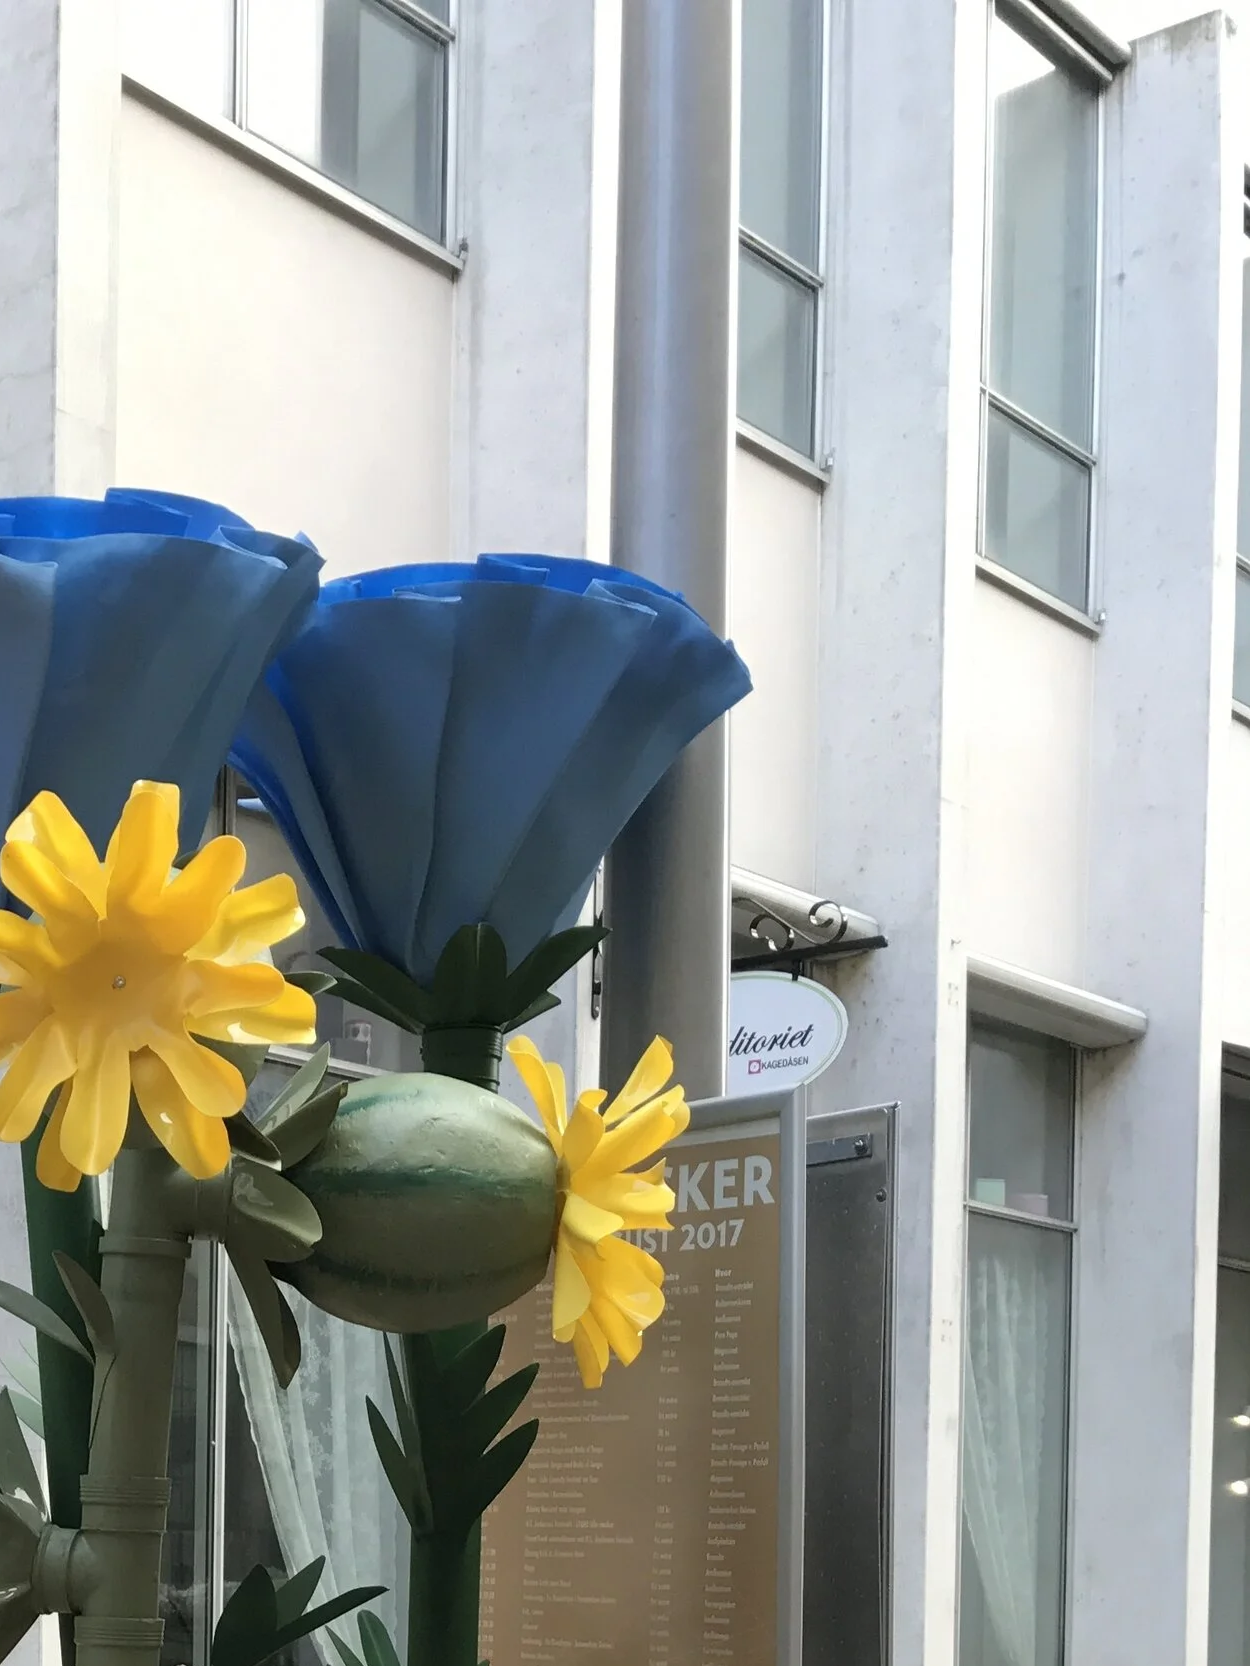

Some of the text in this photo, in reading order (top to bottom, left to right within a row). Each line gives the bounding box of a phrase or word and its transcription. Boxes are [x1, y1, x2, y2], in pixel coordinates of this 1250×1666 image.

[761, 1056, 809, 1070] KAGEDÅSEN
[664, 1155, 775, 1213] KER
[679, 1218, 745, 1251] 2017
